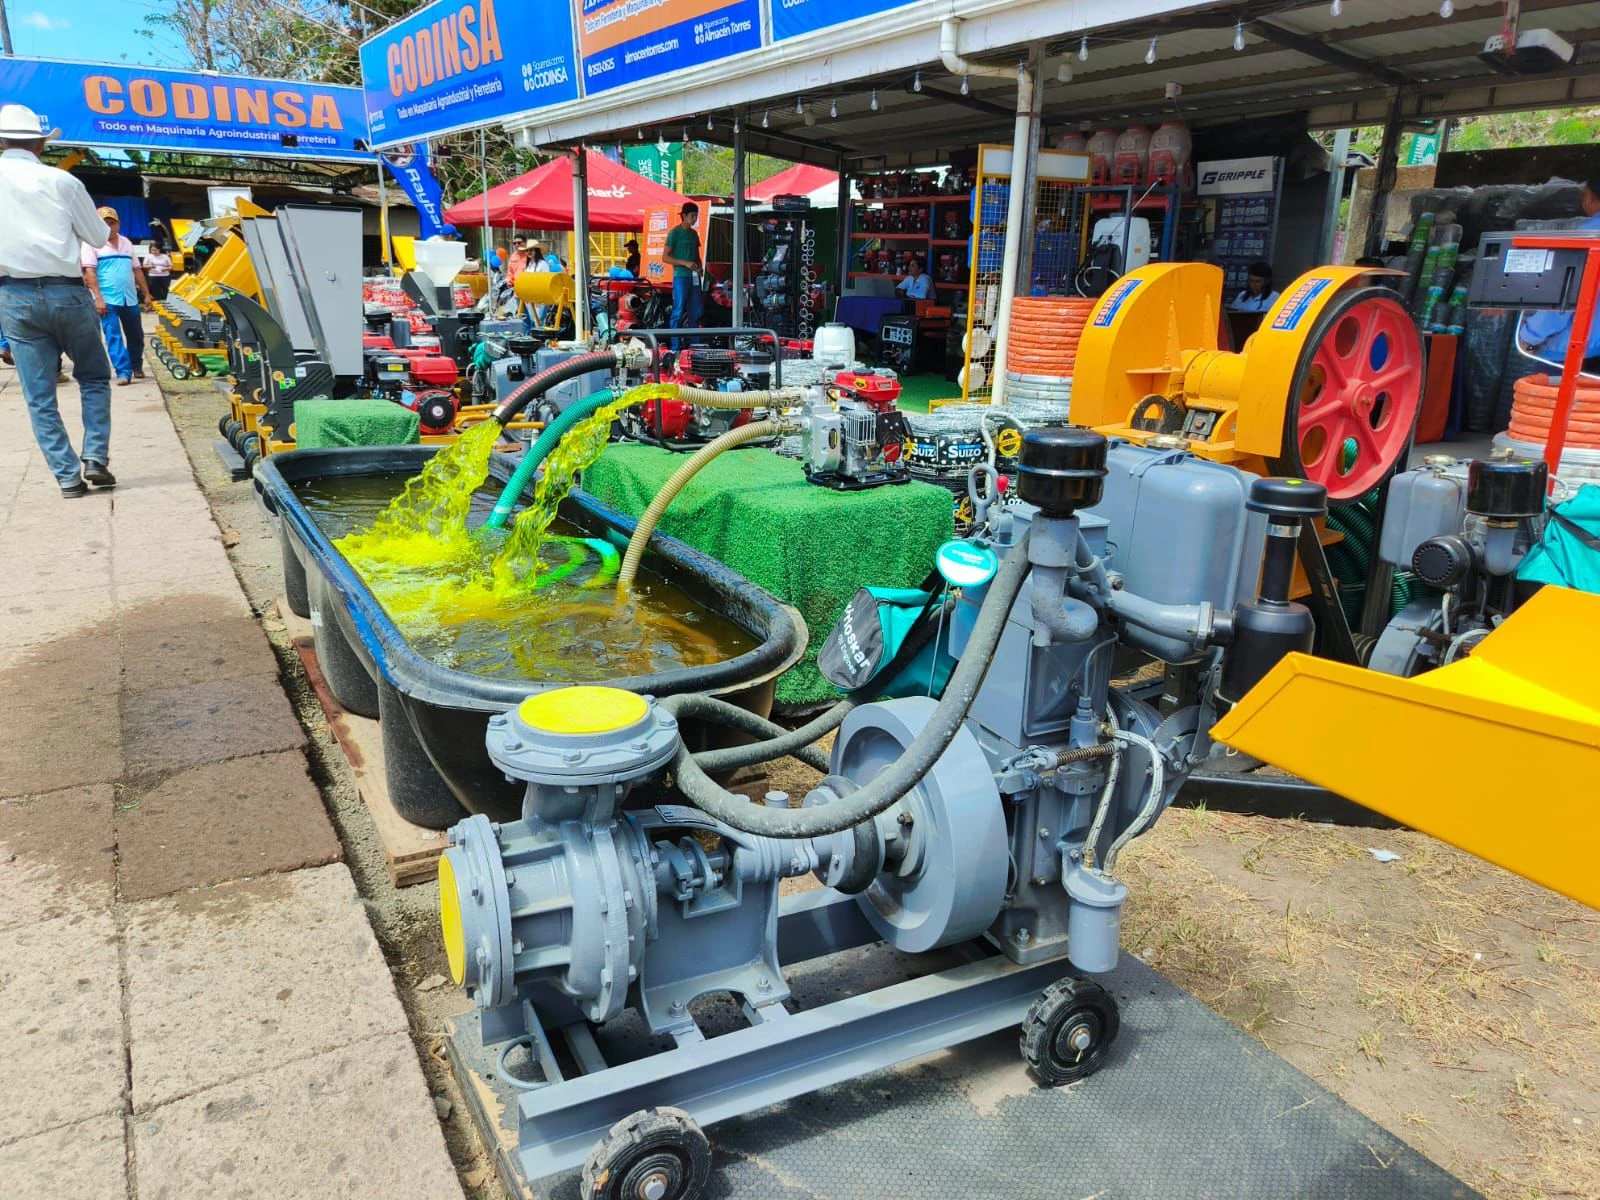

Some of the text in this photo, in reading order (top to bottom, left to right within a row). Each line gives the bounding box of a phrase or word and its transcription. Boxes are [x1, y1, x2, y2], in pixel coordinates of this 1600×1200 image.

[705, 20, 752, 42] Almacén Torres
[387, 0, 504, 97] CODINSA
[624, 39, 679, 64] almacentorres.com
[534, 66, 569, 88] CODINSA
[84, 75, 344, 131] CODINSA
[99, 121, 337, 145] Todo en Maquinaria Agroindustrial erretería
[1218, 169, 1266, 182] GRIPPLE
